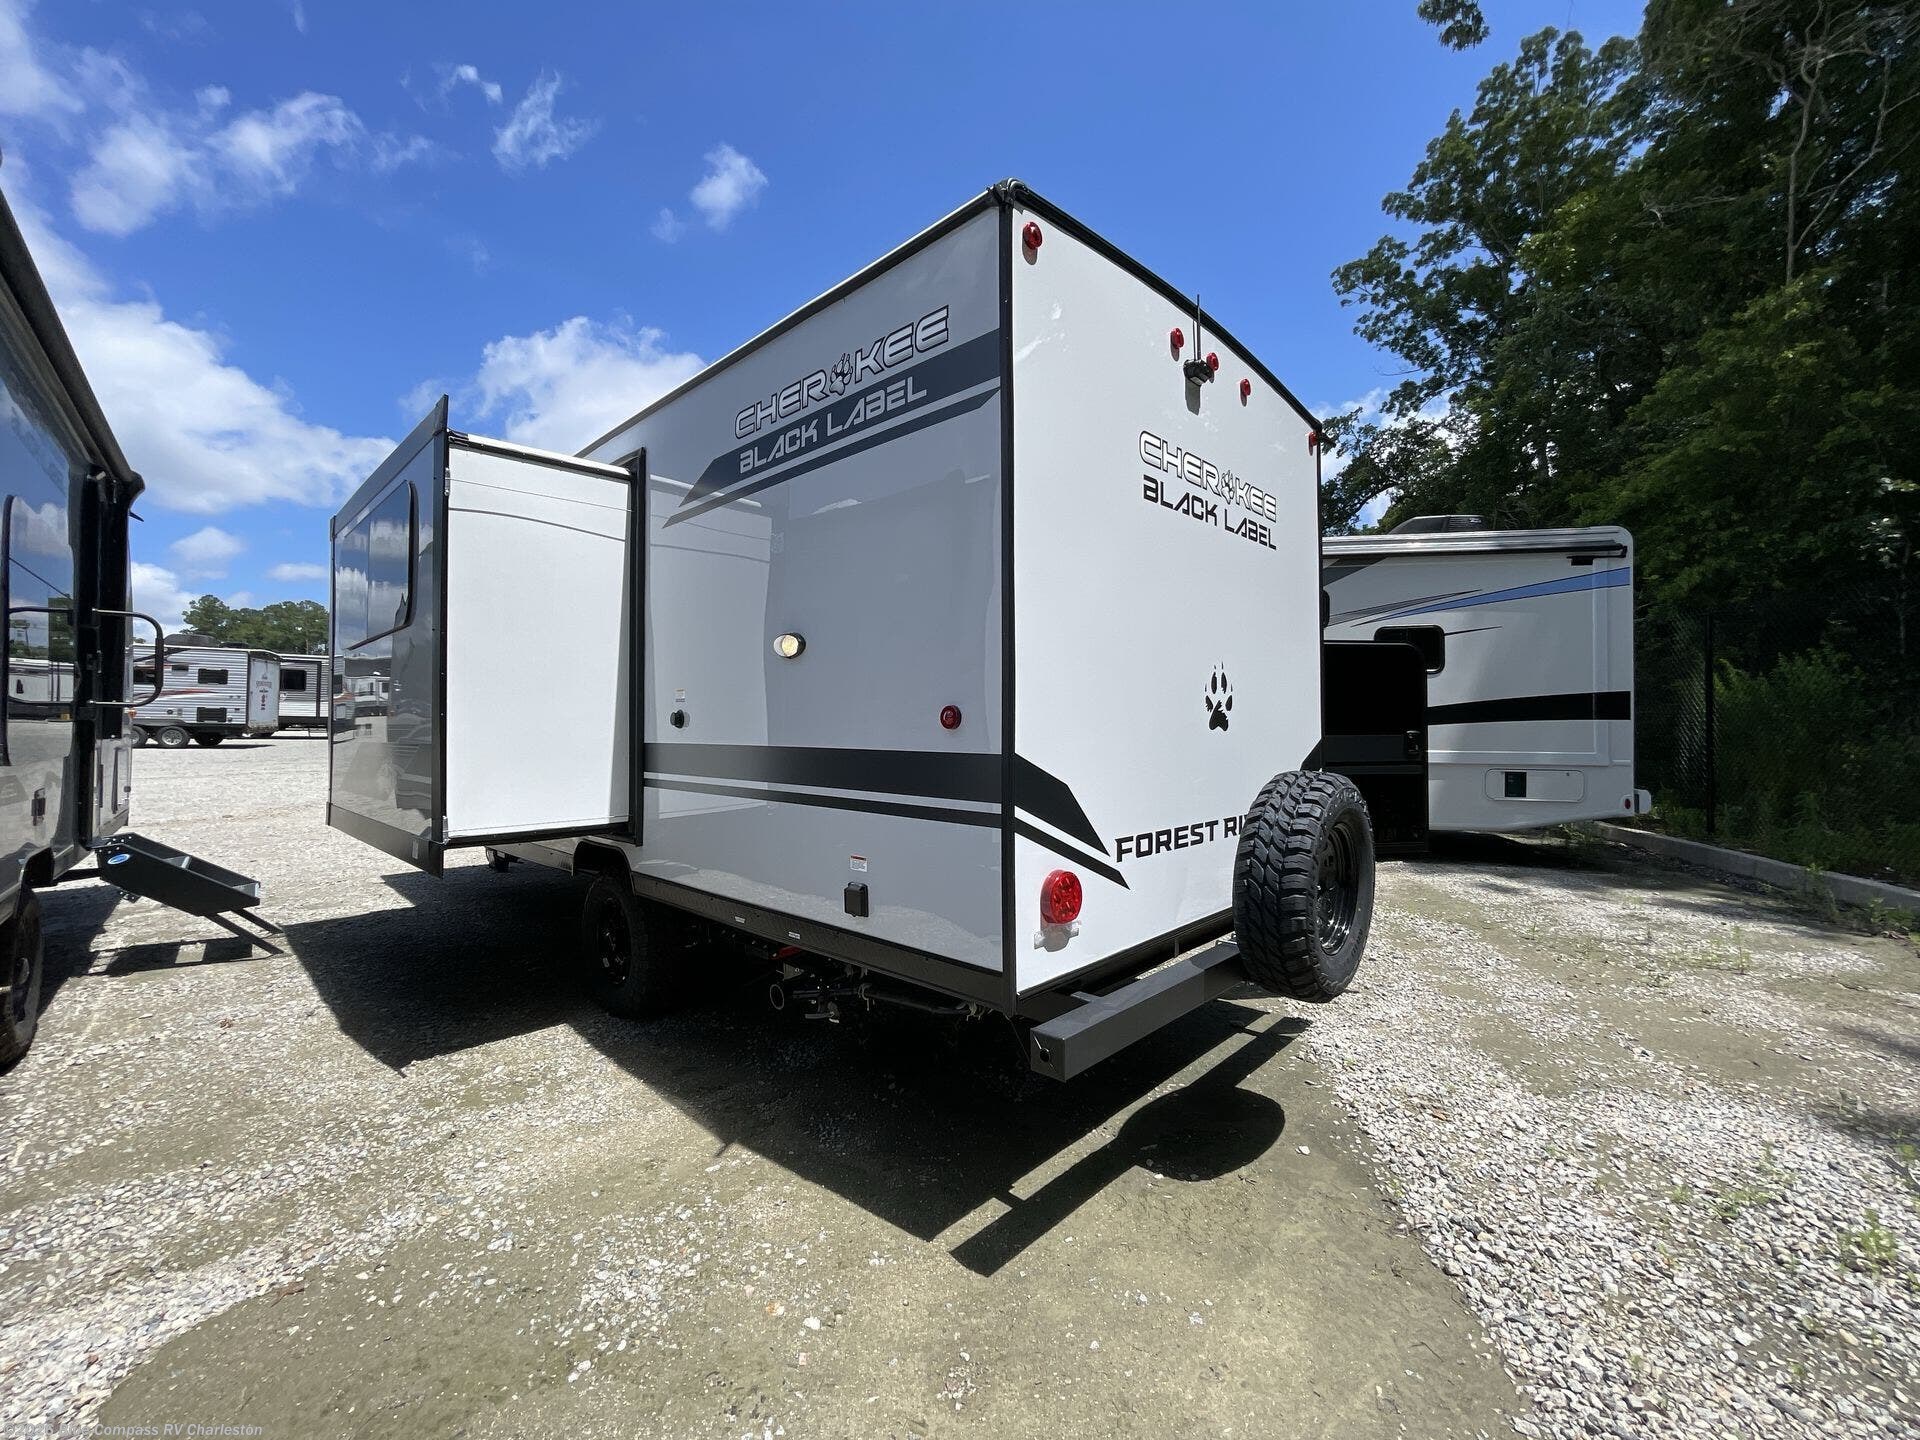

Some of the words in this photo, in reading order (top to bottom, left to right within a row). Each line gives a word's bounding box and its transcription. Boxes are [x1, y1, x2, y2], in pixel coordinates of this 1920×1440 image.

[739, 418, 819, 475] BLACK
[826, 376, 928, 438] LABEL
[1143, 474, 1218, 527] BLACK
[1224, 508, 1277, 551] LABEL
[1114, 819, 1219, 863] FOREST
